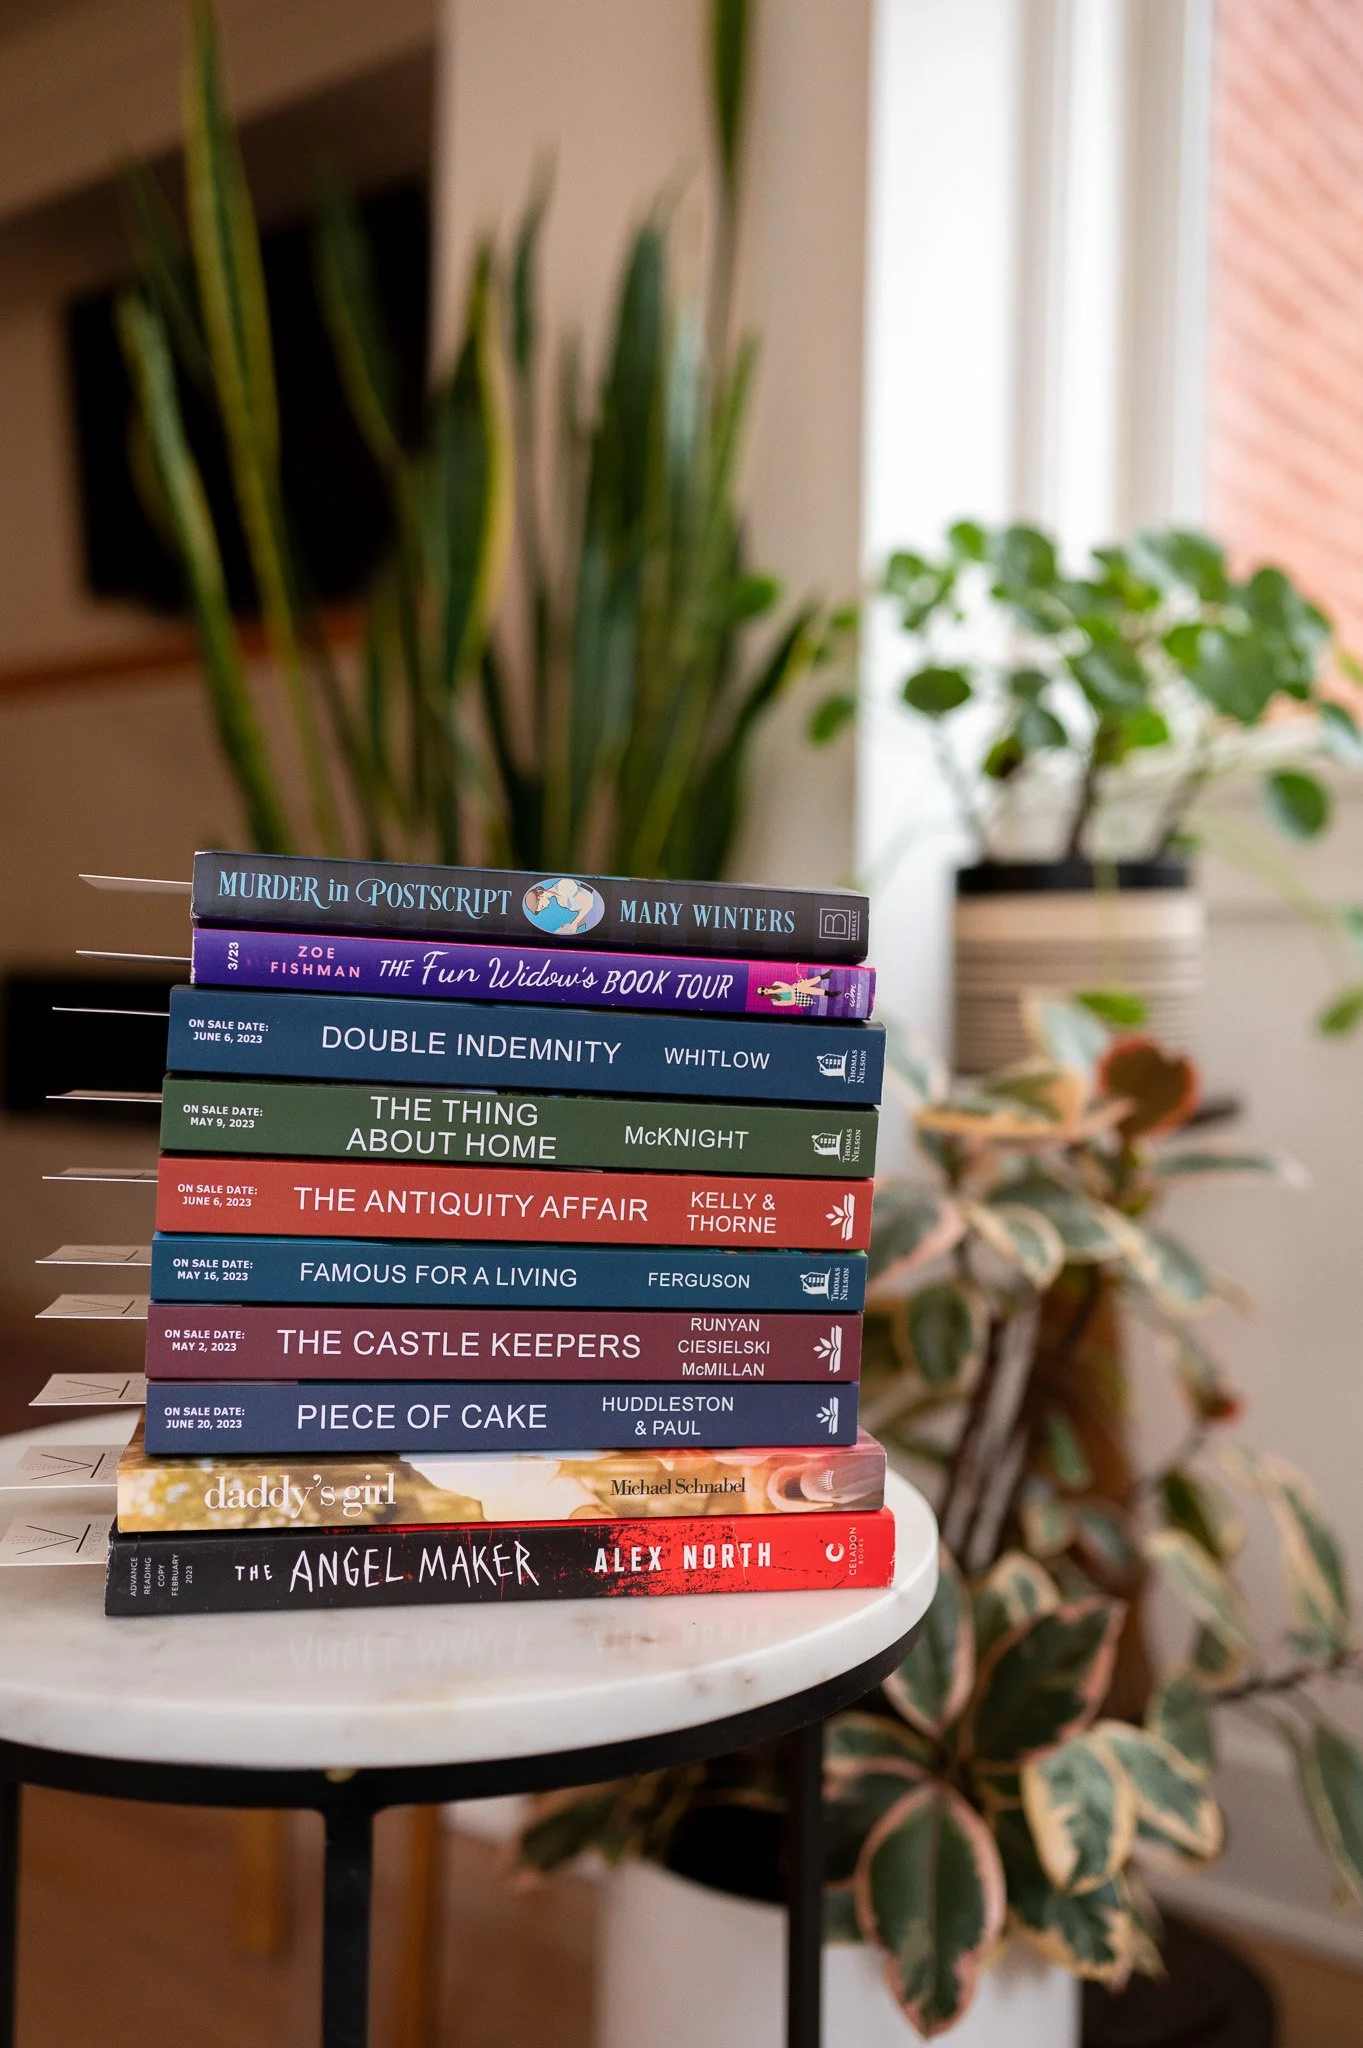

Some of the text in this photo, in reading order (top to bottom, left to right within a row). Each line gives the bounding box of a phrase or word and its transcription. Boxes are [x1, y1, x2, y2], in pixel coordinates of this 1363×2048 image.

[218, 870, 512, 920] MURDER in POSTSCRIPT
[620, 899, 796, 934] MARY WINTERS
[228, 941, 240, 970] 3/23
[298, 945, 336, 960] ZOE
[270, 961, 361, 978] FISHMAN
[379, 950, 734, 1000] THE Fun Widow's BOOK TOUR
[188, 1018, 269, 1032] ON SALE DATE:
[193, 1031, 263, 1044] JUNE 6, 2023
[322, 1026, 622, 1065] DOUBLE INDEMNITY
[664, 1047, 771, 1070] WHITLOW
[848, 1049, 858, 1084] THOMAS
[857, 1050, 867, 1084] NELSON
[183, 1104, 264, 1117] ON SALE DATE:
[190, 1117, 255, 1129] MAY 9, 2023
[370, 1096, 539, 1127] THE THING
[346, 1128, 557, 1160] ABOUT HOME
[625, 1125, 749, 1150] McKNIGHT
[842, 1128, 853, 1163] THOMAS
[852, 1129, 862, 1163] NELSON
[177, 1184, 258, 1196] ON SALE DATE:
[182, 1196, 252, 1208] JUNE 6, 2023
[691, 1191, 776, 1211] KELLY &
[294, 1186, 649, 1222] THE ANTIQUITY AFFAIR
[686, 1214, 777, 1234] THORNE
[173, 1258, 254, 1270] ON SALE DATE:
[177, 1270, 249, 1283] MAY 16, 2023
[300, 1262, 578, 1288] FAMOUS FOR A LIVING
[648, 1272, 750, 1289] FERGUSON
[831, 1267, 841, 1302] THOMAS
[840, 1267, 850, 1302] NELSON
[164, 1329, 246, 1340] ON SALE DATE:
[691, 1318, 760, 1333] RUNYAN
[171, 1342, 237, 1353] MAY 2, 2023
[277, 1329, 641, 1359] THE CASTLE KEEPERS
[678, 1339, 771, 1355] CIESIELSKI
[682, 1362, 765, 1377] McMILLAN
[164, 1406, 246, 1417] ON SALE DATE:
[297, 1404, 547, 1430] PIECE OF CAKE
[602, 1396, 735, 1413] HUDDLESTON
[166, 1418, 242, 1431] JUNE 20, 2023
[634, 1420, 701, 1436] & PAUL
[205, 1473, 396, 1519] daddy's girl
[610, 1476, 746, 1497] Michael Schnabel
[594, 1542, 771, 1574] ALEX NORTH
[849, 1526, 858, 1576] CELADON
[857, 1537, 865, 1565] BOOKS
[130, 1557, 138, 1597] ADVANCE
[144, 1556, 152, 1595] READING
[158, 1563, 166, 1588] COPY
[171, 1553, 179, 1596] FEBRUARY
[235, 1541, 540, 1593] THE ANGEL MAKER
